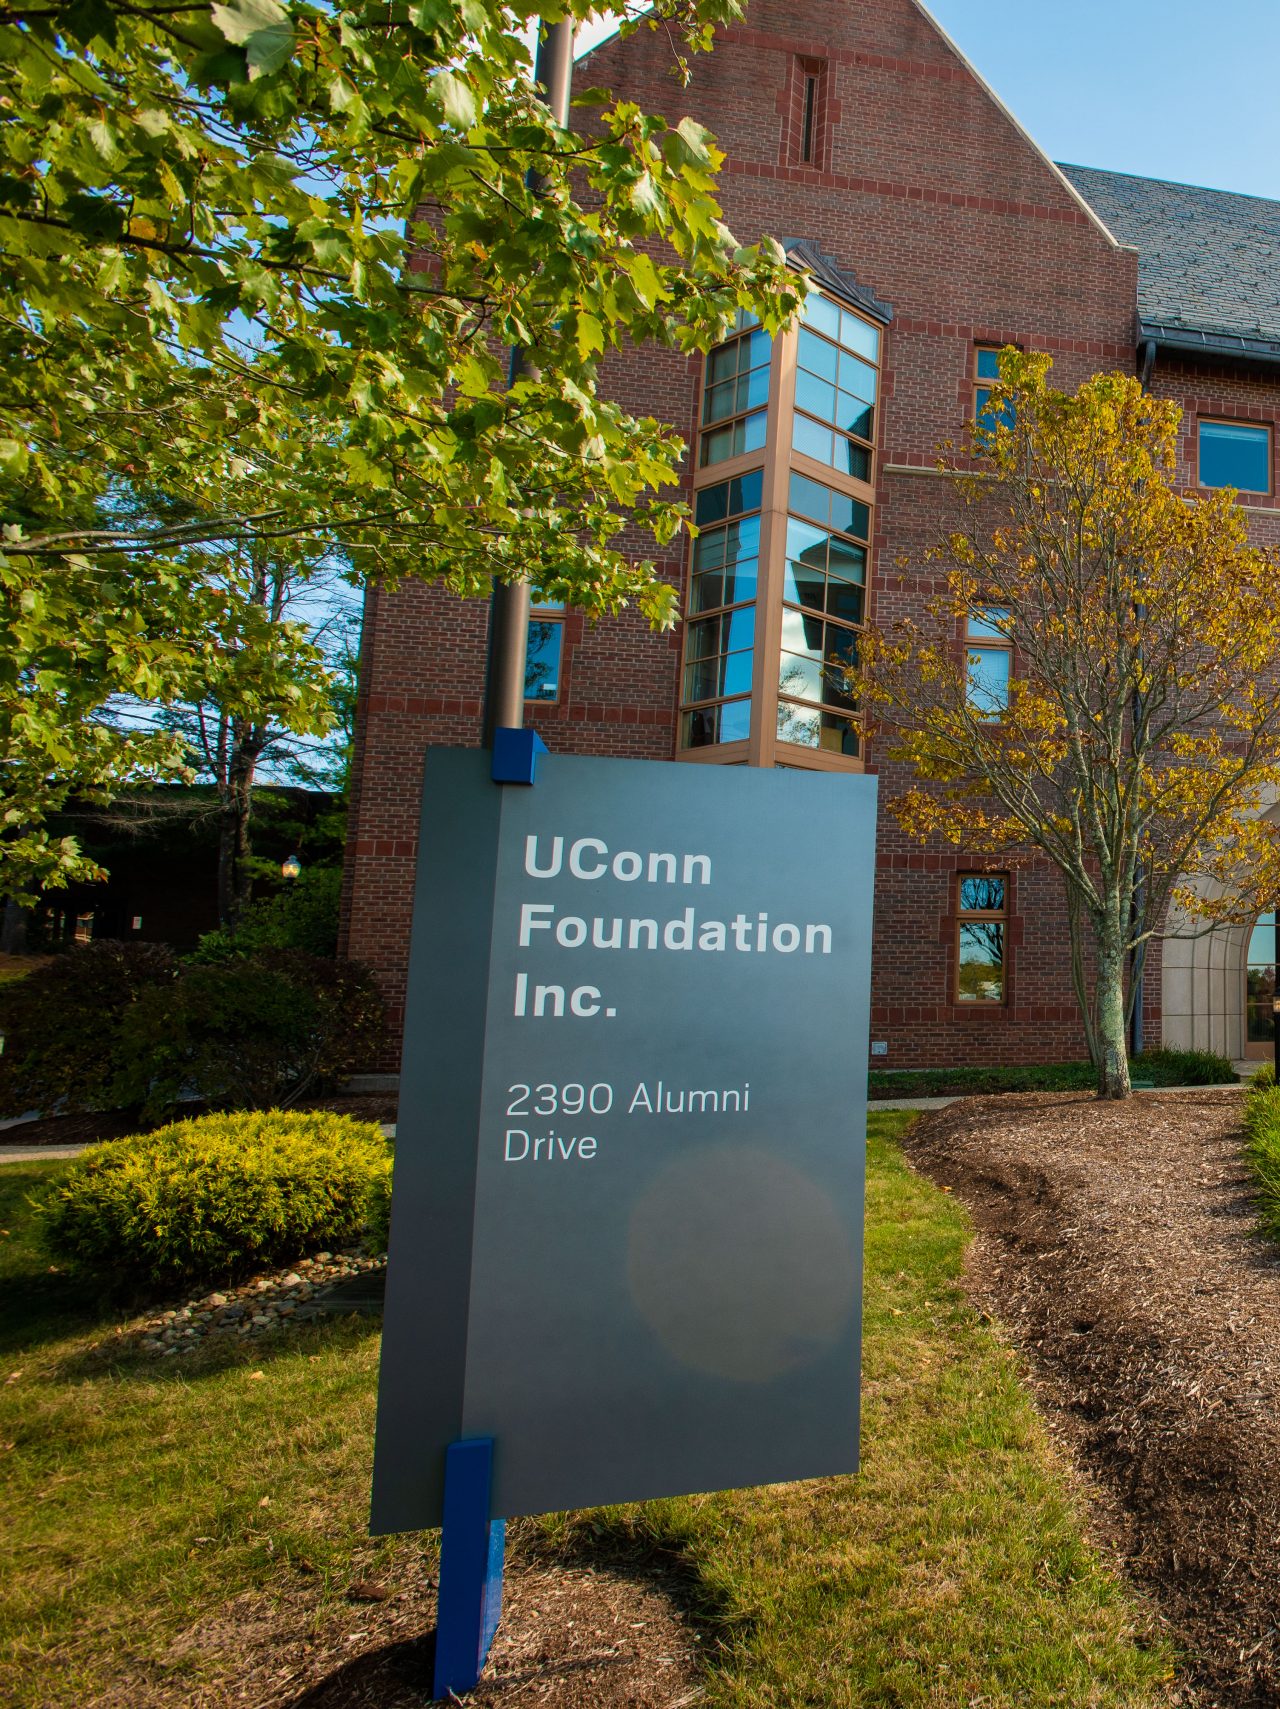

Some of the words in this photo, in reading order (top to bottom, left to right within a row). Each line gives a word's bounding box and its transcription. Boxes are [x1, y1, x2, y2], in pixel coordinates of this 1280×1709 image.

[524, 835, 712, 885] UConn
[518, 903, 833, 954] Foundation
[513, 972, 617, 1017] Inc.
[505, 1082, 614, 1117] 2390
[628, 1081, 751, 1114] Alumni
[504, 1129, 598, 1162] Drive
